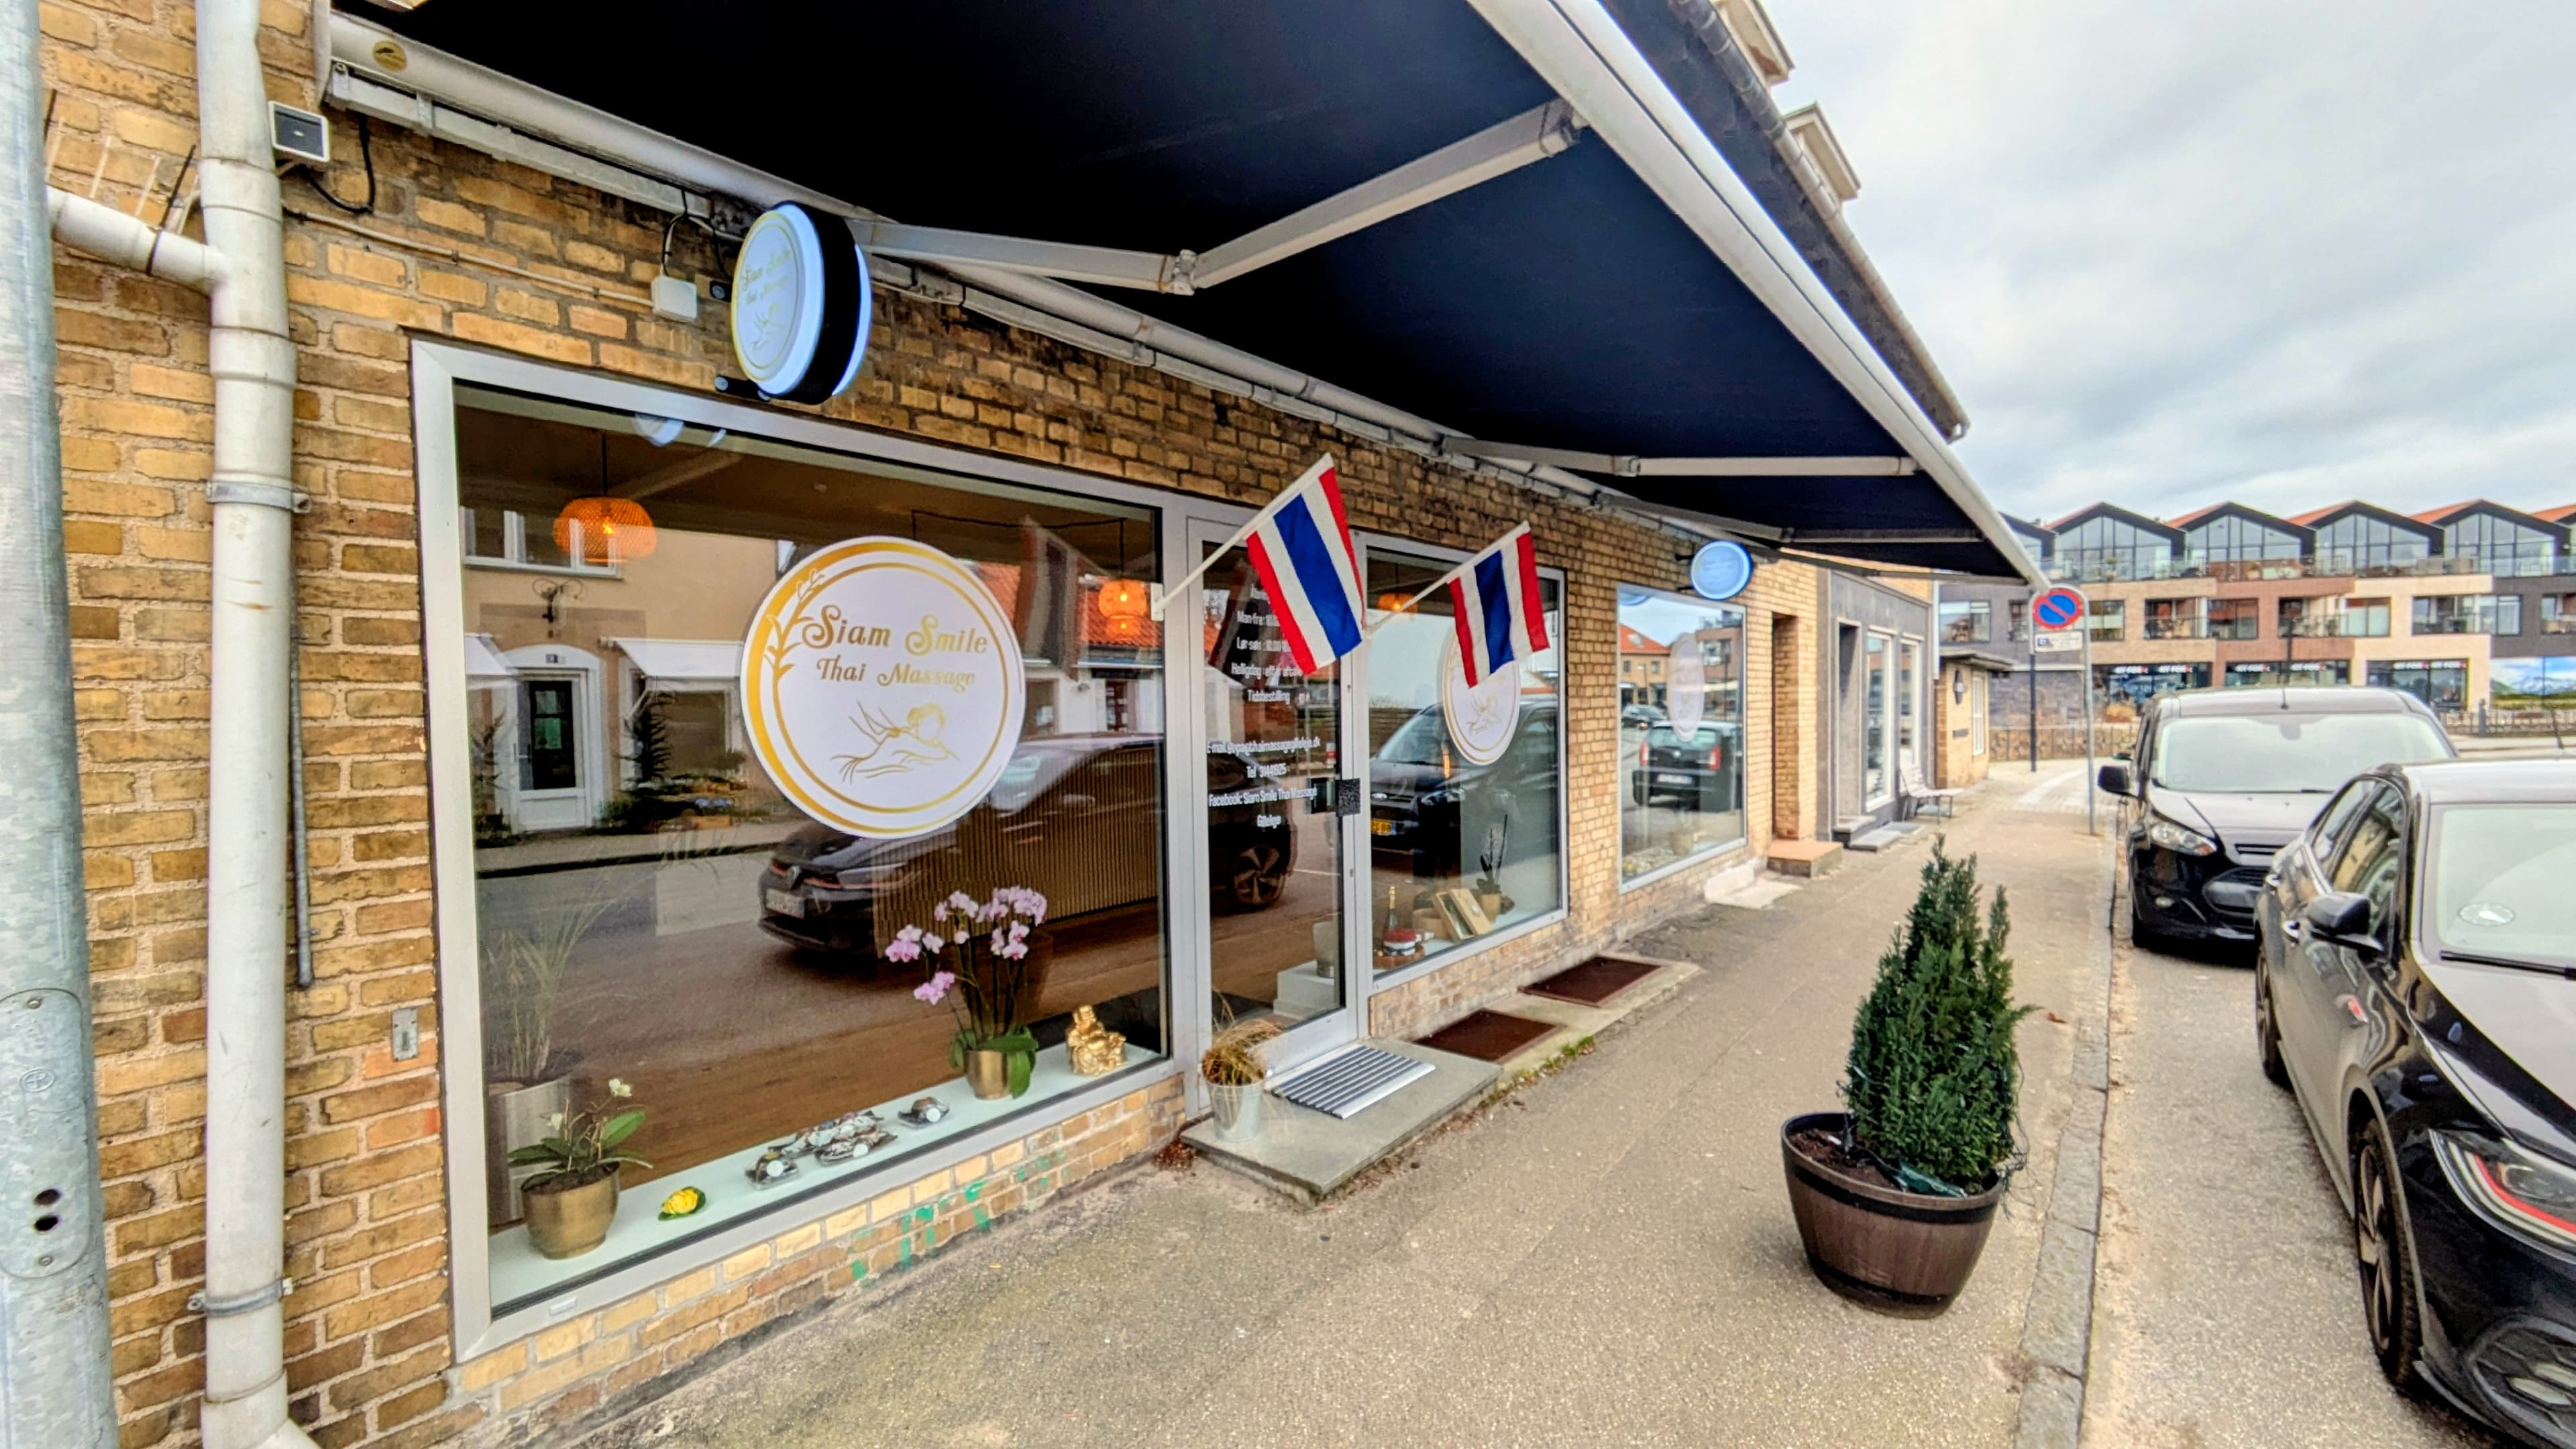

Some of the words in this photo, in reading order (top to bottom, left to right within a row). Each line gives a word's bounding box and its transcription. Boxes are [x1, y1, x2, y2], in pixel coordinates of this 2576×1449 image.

[802, 604, 891, 649] Siam
[905, 614, 988, 656] Smile
[816, 654, 866, 682] Thai
[877, 662, 975, 692] Massage
